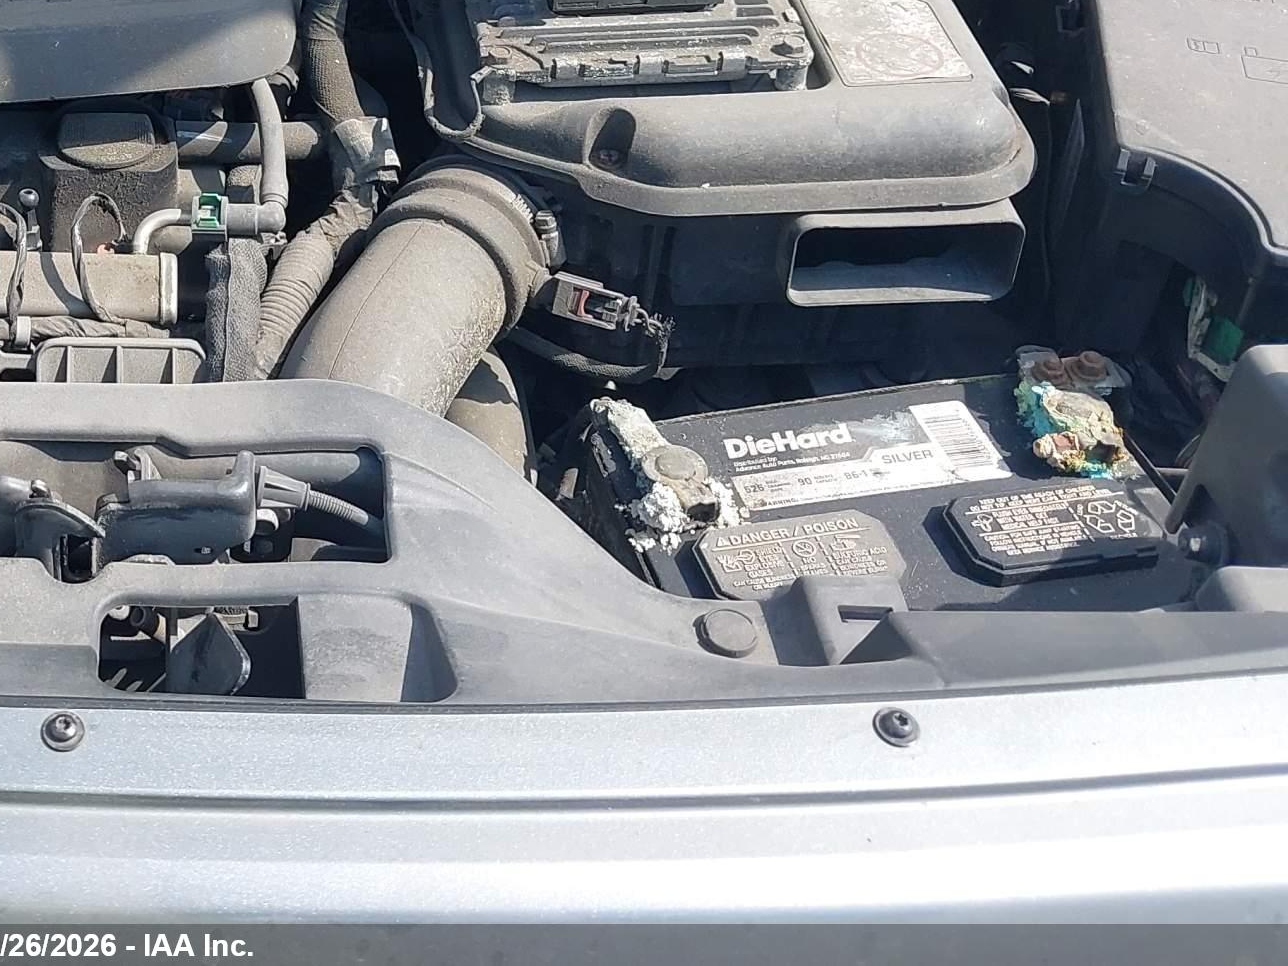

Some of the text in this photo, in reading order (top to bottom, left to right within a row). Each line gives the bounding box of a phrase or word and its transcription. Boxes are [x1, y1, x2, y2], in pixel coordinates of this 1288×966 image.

[723, 422, 854, 459] DieHard
[882, 449, 932, 464] SILVER
[797, 475, 812, 486] 90
[728, 527, 791, 545] DANGER
[803, 518, 859, 537] POISON
[802, 556, 816, 564] NO
